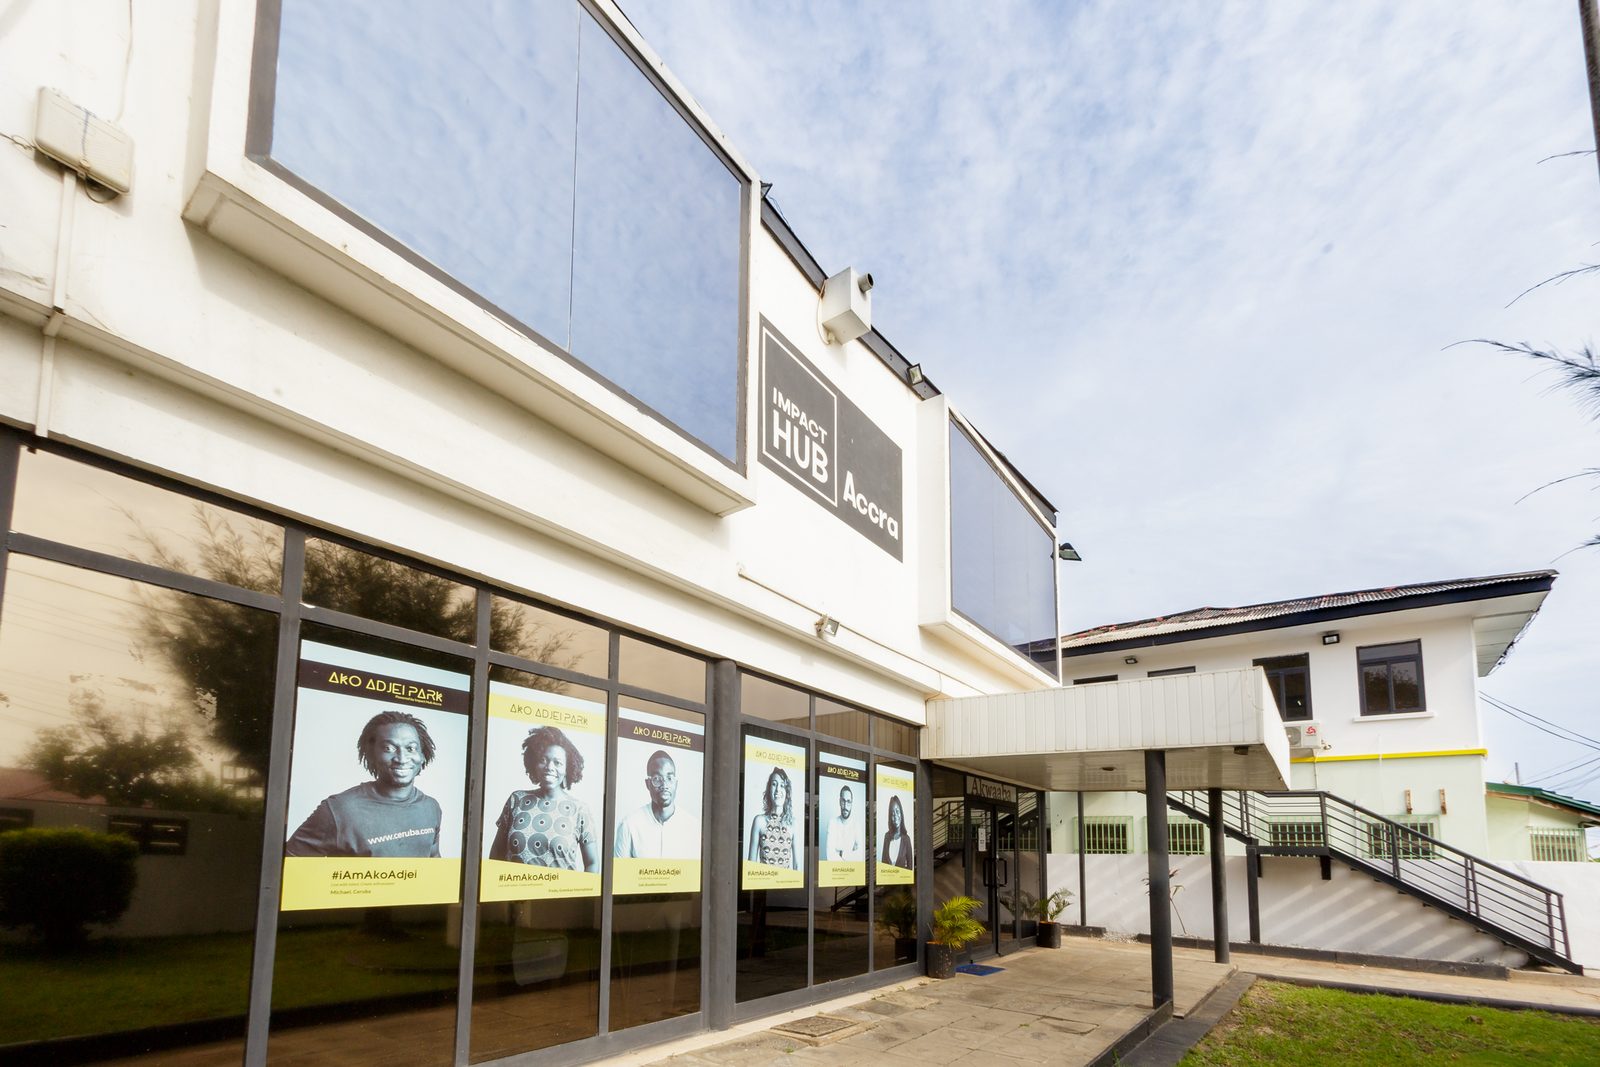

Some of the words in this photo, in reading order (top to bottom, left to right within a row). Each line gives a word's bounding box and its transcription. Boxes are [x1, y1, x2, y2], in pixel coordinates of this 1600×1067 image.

[773, 386, 828, 444] IMPACT
[773, 409, 829, 484] HUB
[843, 470, 899, 540] Accra
[328, 671, 362, 687] AKO
[365, 679, 406, 696] ADJEI
[407, 686, 443, 703] PARK
[510, 703, 533, 716] AKO
[535, 708, 563, 720] ADJEI
[564, 712, 589, 726] PARK
[651, 729, 672, 741] ADJEI
[672, 733, 692, 745] PARK
[971, 777, 1011, 800] Akwaaba
[367, 827, 434, 845] www.ceruba.com
[332, 870, 418, 881] #iAmAkoAdjei
[498, 873, 560, 882] #iAmAkoAdjei
